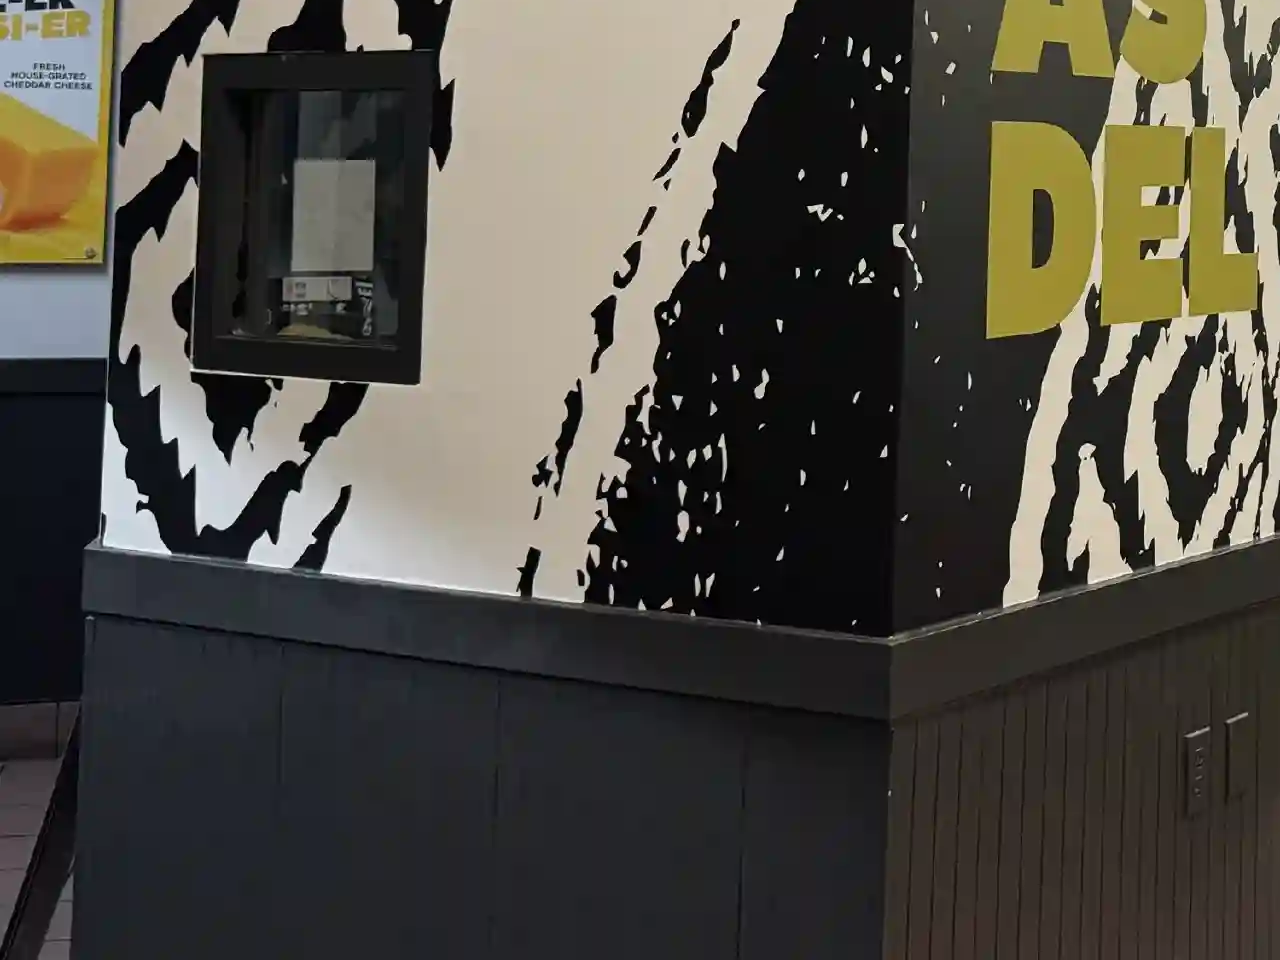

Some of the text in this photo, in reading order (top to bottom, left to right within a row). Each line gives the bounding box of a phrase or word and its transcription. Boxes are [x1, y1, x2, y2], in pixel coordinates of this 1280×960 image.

[33, 62, 66, 70] FRESH
[11, 72, 87, 81] HOUSE-GRATED
[4, 80, 93, 90] CHEDDAR CHEESE
[986, 120, 1259, 340] DEL
